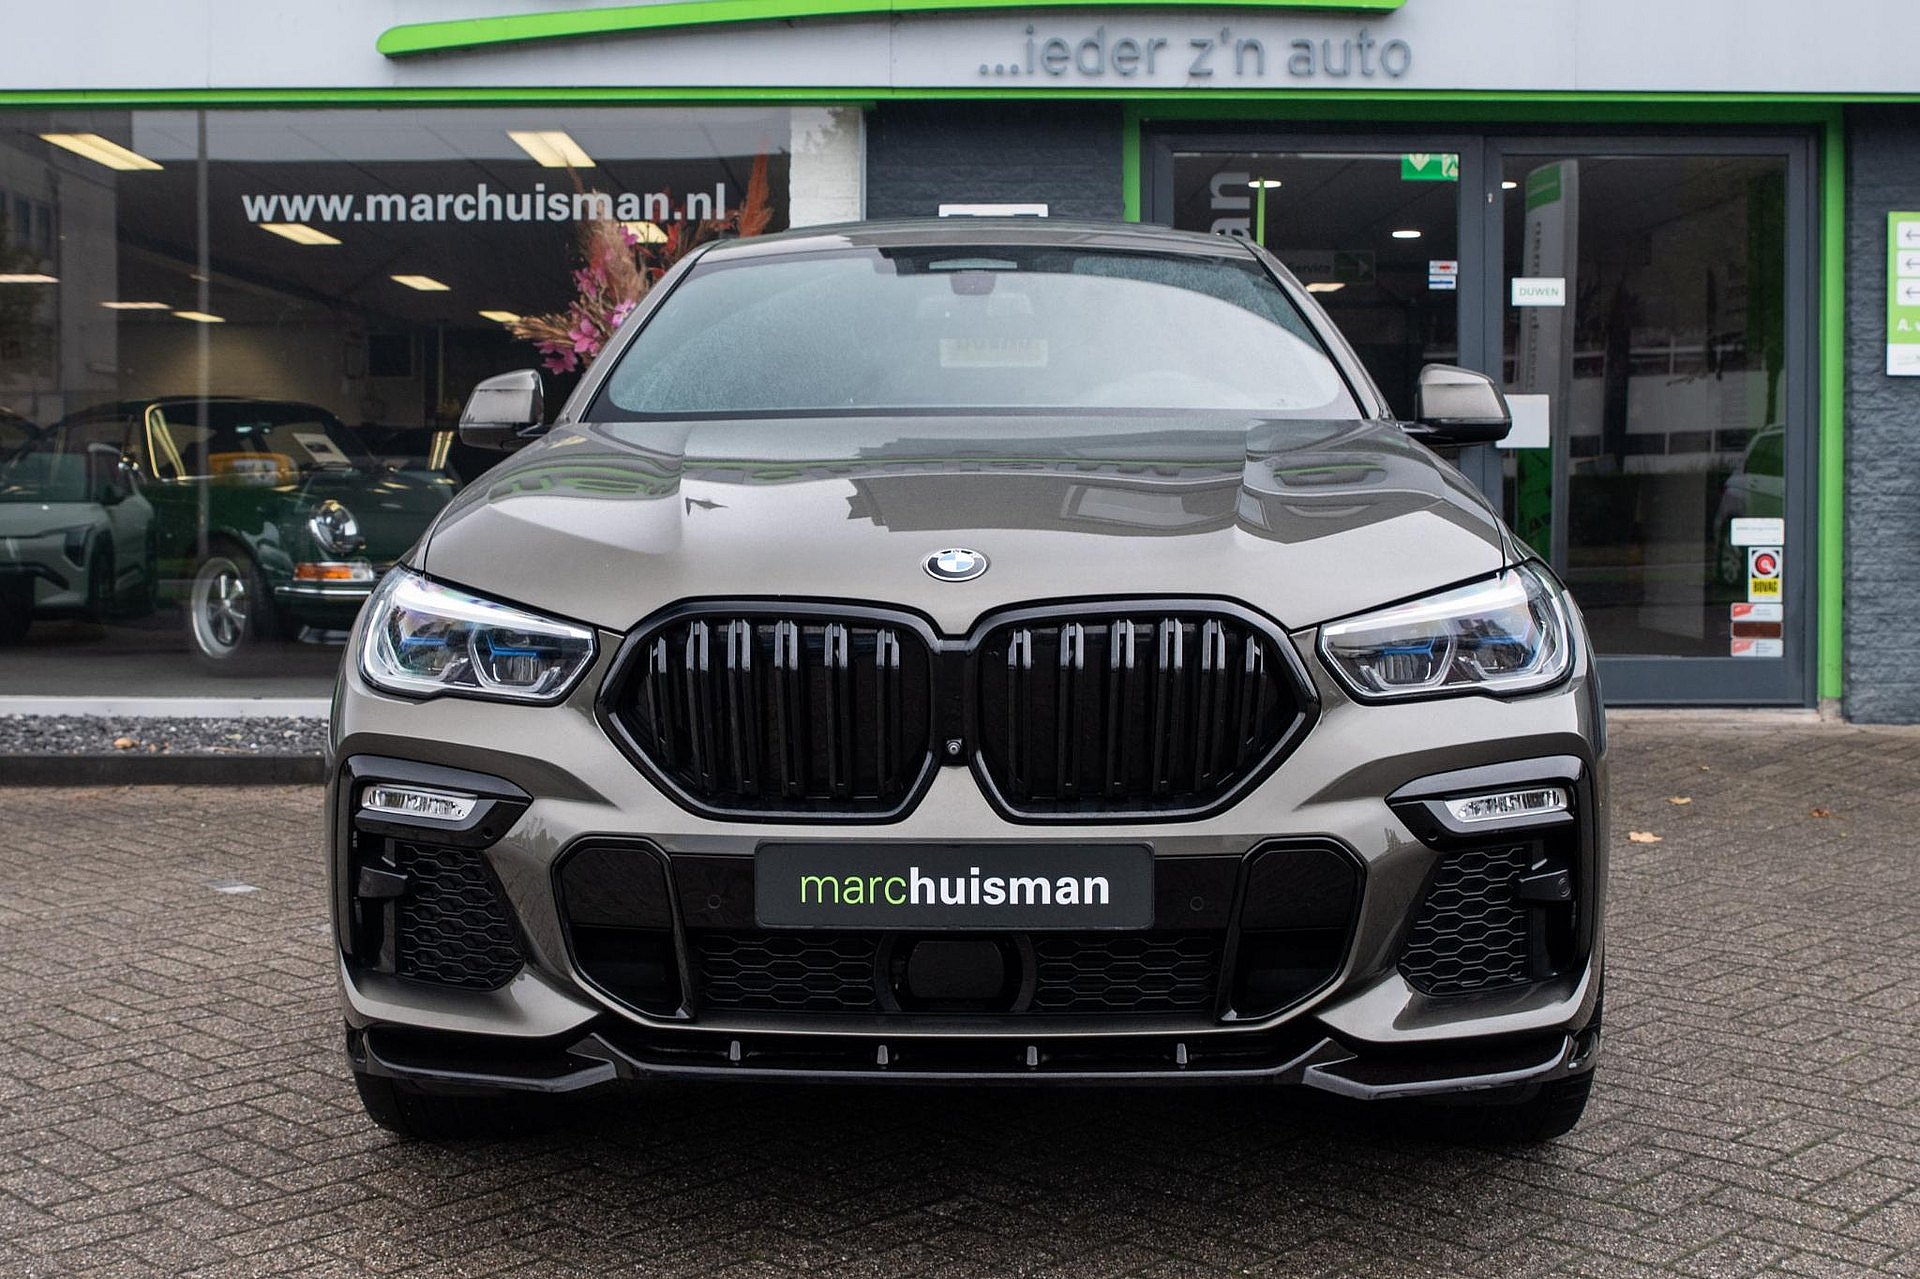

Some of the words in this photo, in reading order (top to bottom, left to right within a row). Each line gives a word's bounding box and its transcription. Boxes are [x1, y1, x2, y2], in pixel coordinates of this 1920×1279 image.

[979, 24, 1168, 77] ...ieder
[1186, 26, 1266, 77] z'n
[1287, 28, 1412, 77] auto
[242, 183, 725, 221] www.marchuisman.nl
[1519, 287, 1559, 297] DUWEN
[801, 867, 1109, 905] marchuisman
